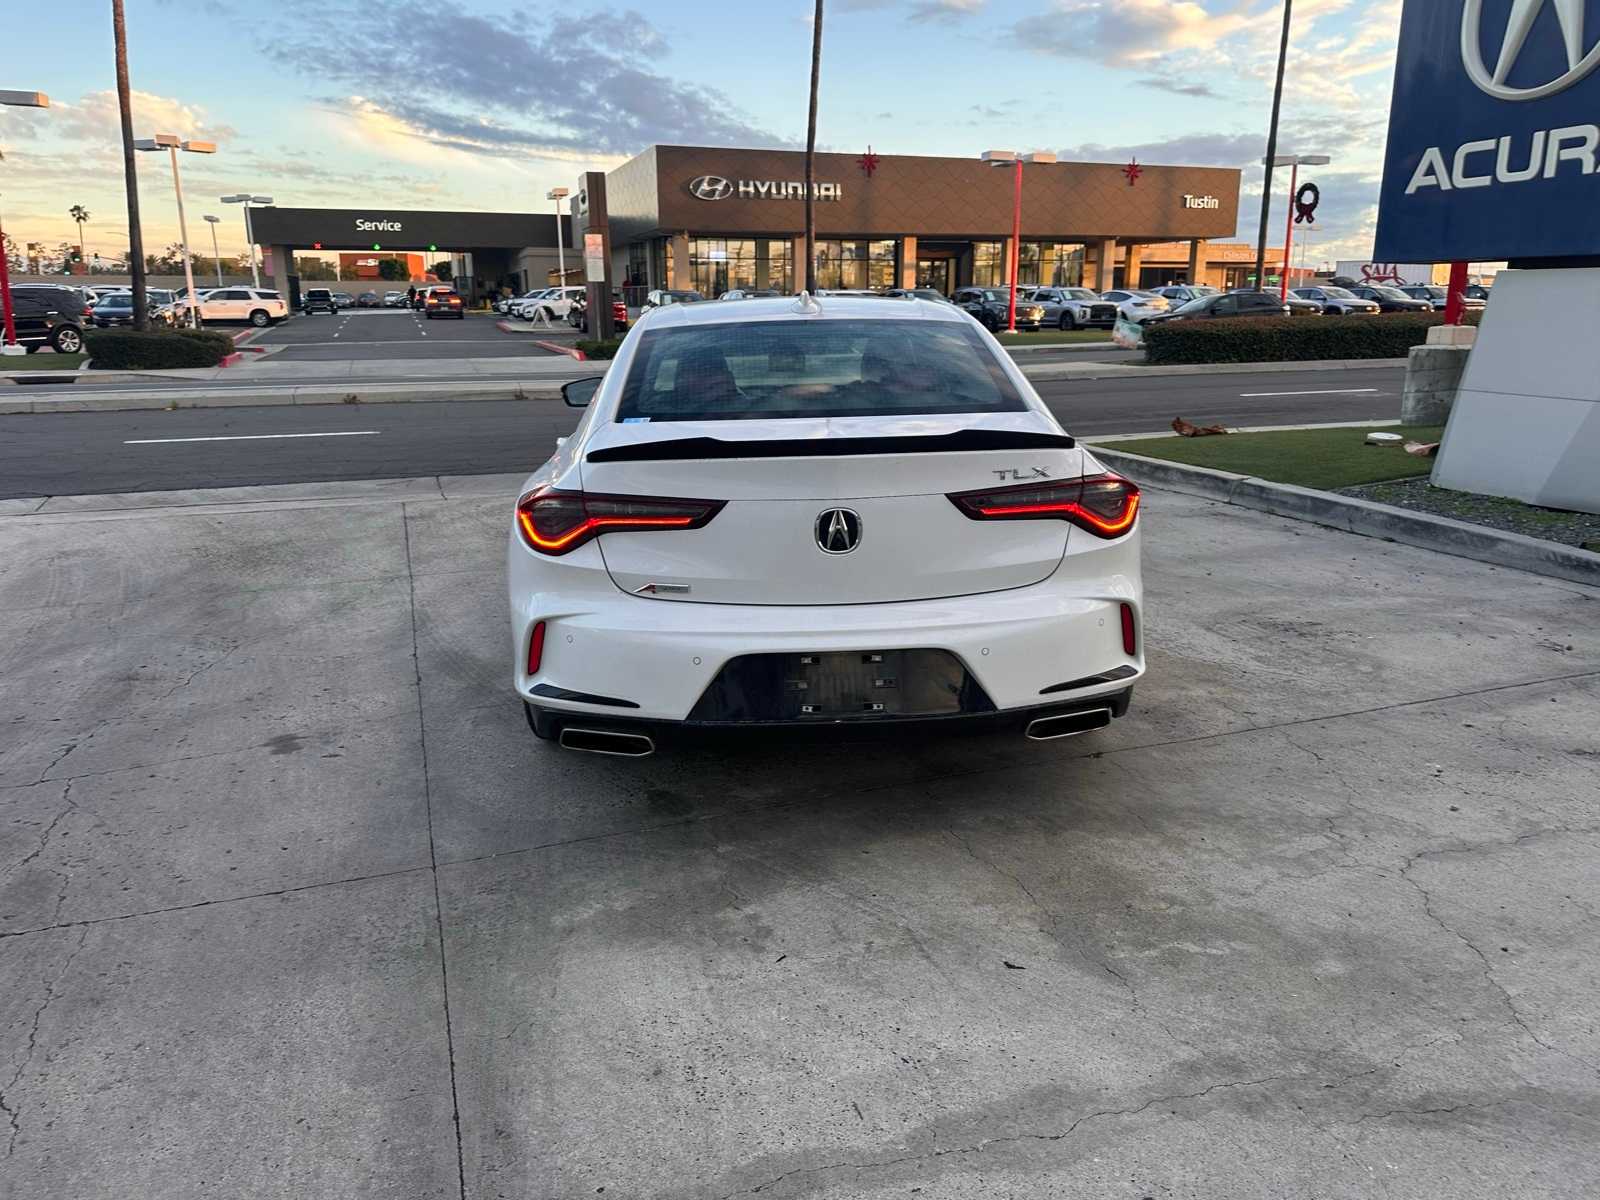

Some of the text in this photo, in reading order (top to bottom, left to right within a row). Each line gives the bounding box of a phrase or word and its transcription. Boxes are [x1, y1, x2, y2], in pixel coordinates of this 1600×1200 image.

[1405, 124, 1600, 194] ACUR
[1184, 194, 1219, 208] Tustin
[355, 219, 402, 231] Service
[992, 466, 1050, 481] TLX
